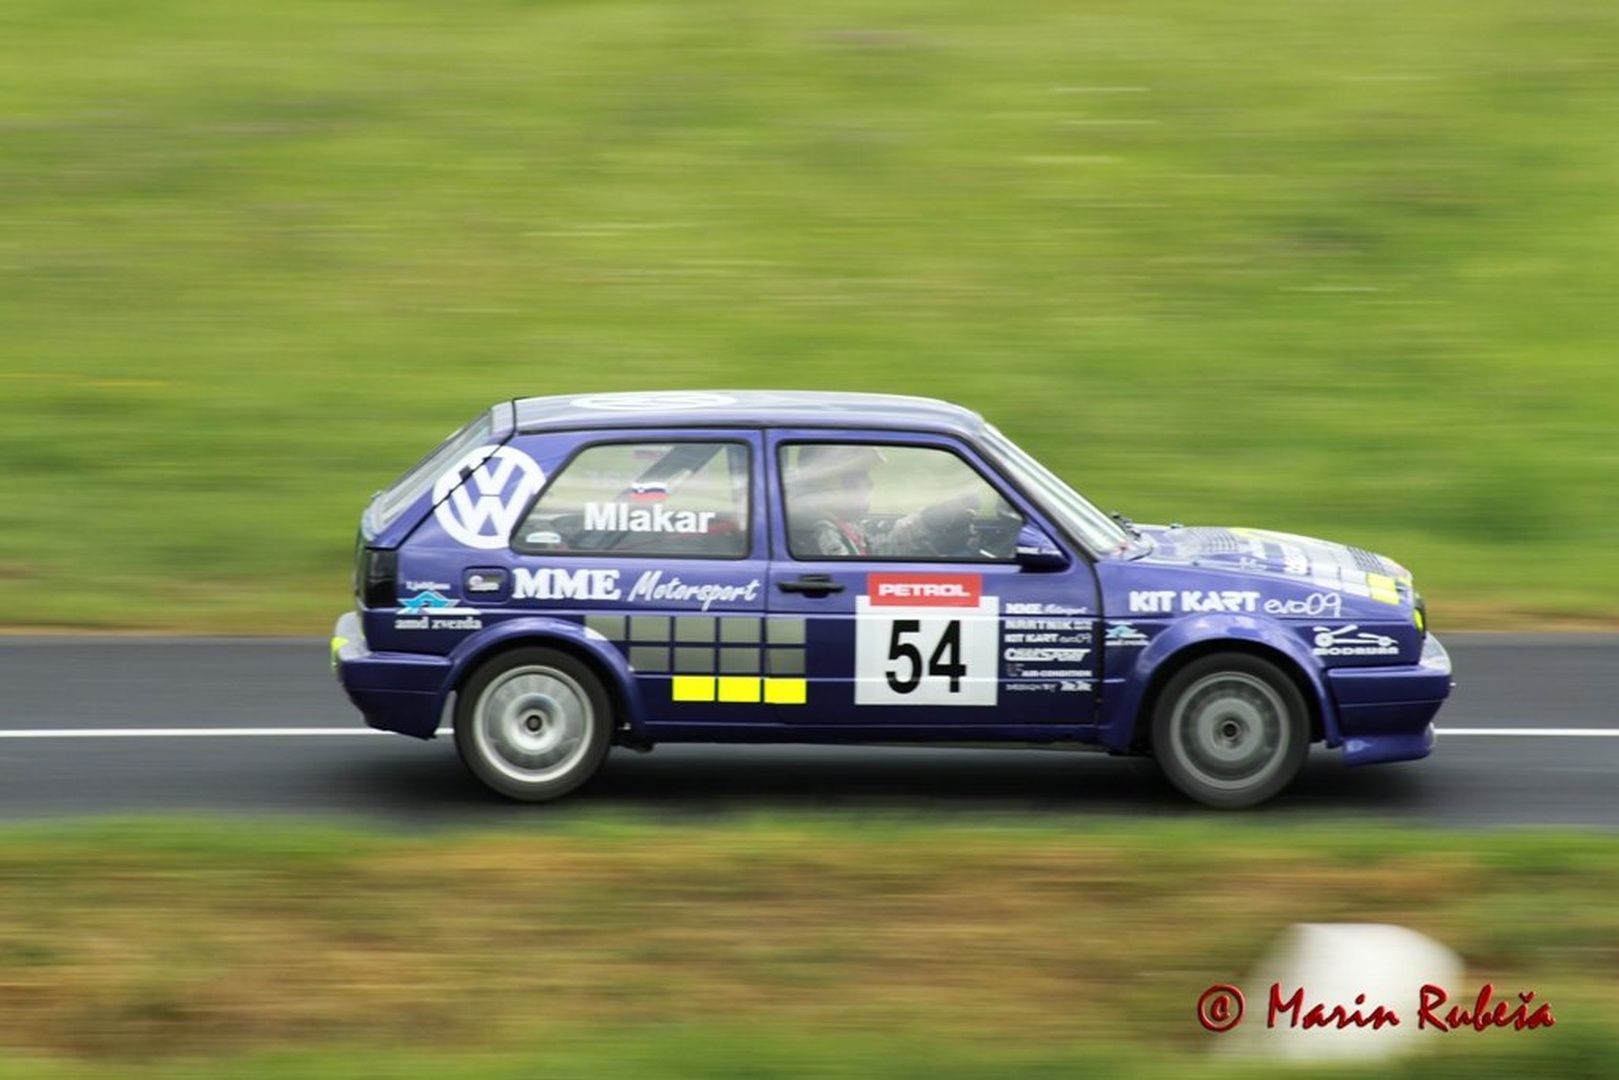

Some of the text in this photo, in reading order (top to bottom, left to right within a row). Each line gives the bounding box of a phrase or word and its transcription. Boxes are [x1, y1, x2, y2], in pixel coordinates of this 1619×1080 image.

[584, 502, 716, 533] Mlakar
[511, 568, 621, 600] MME
[627, 570, 760, 611] Motorsport
[878, 583, 971, 597] PETROL
[1129, 591, 1341, 617] KIT KART evo09
[885, 619, 967, 694] 54
